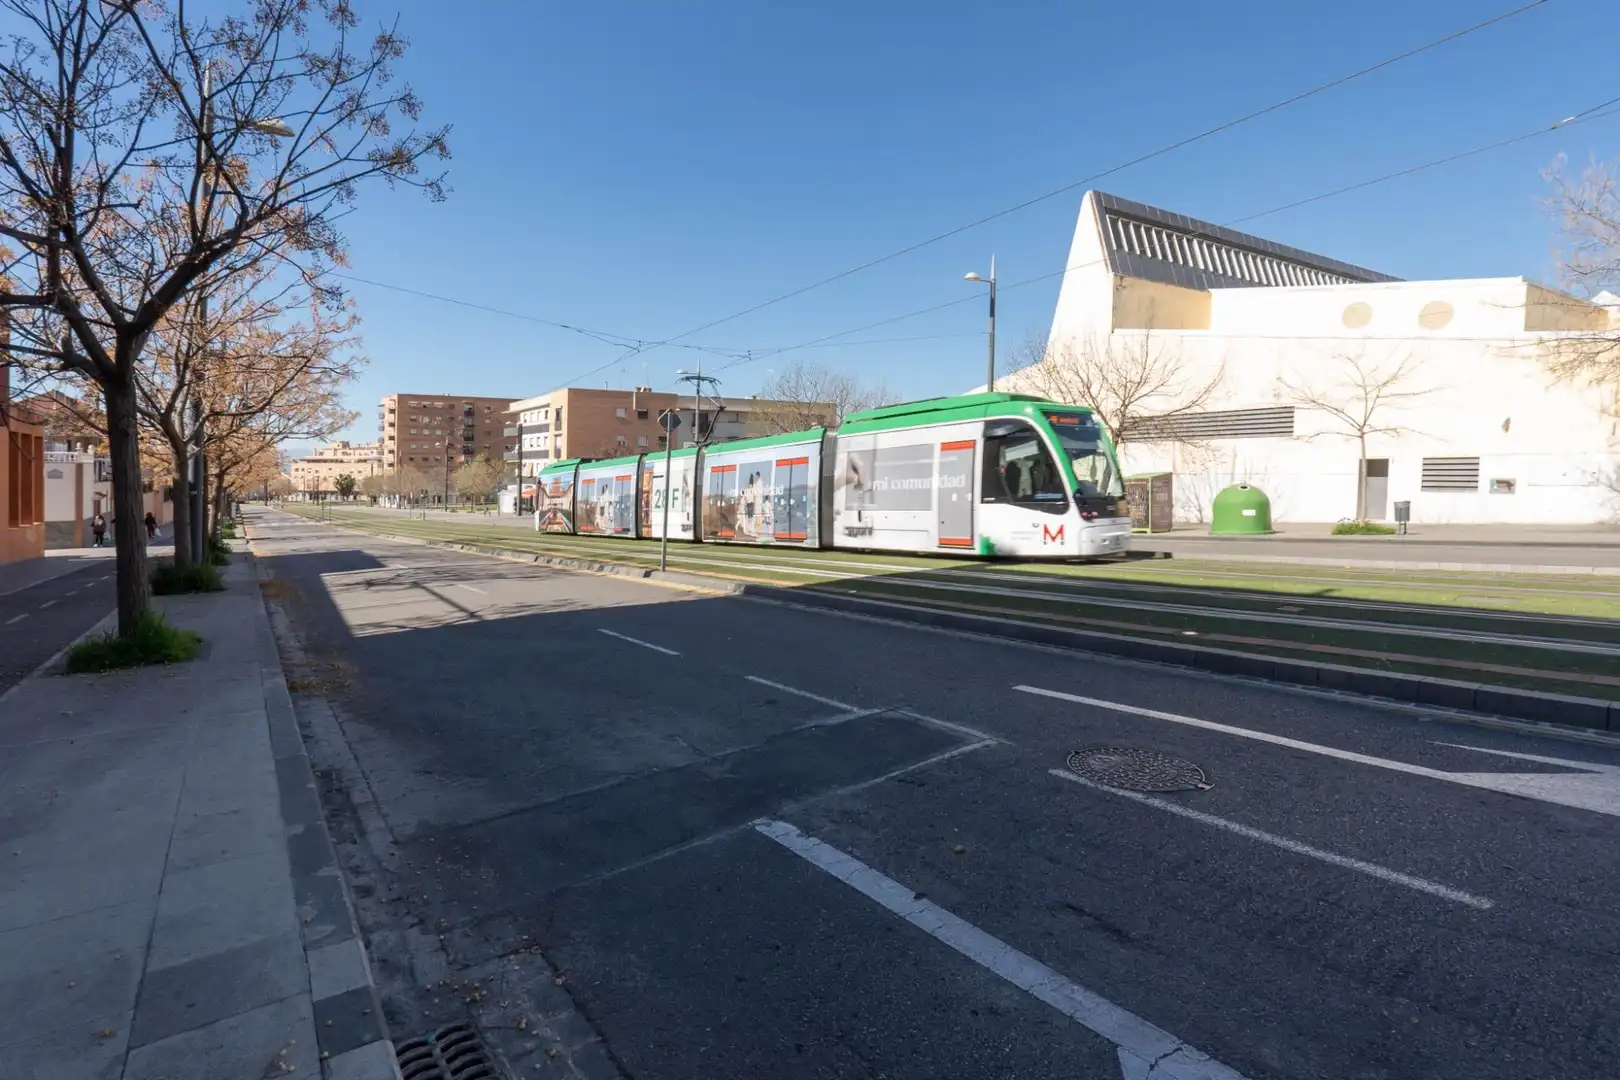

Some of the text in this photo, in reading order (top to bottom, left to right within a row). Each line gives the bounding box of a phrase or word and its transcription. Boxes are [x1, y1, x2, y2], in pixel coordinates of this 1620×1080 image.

[873, 473, 967, 491] mi comundad
[1043, 523, 1065, 545] M
